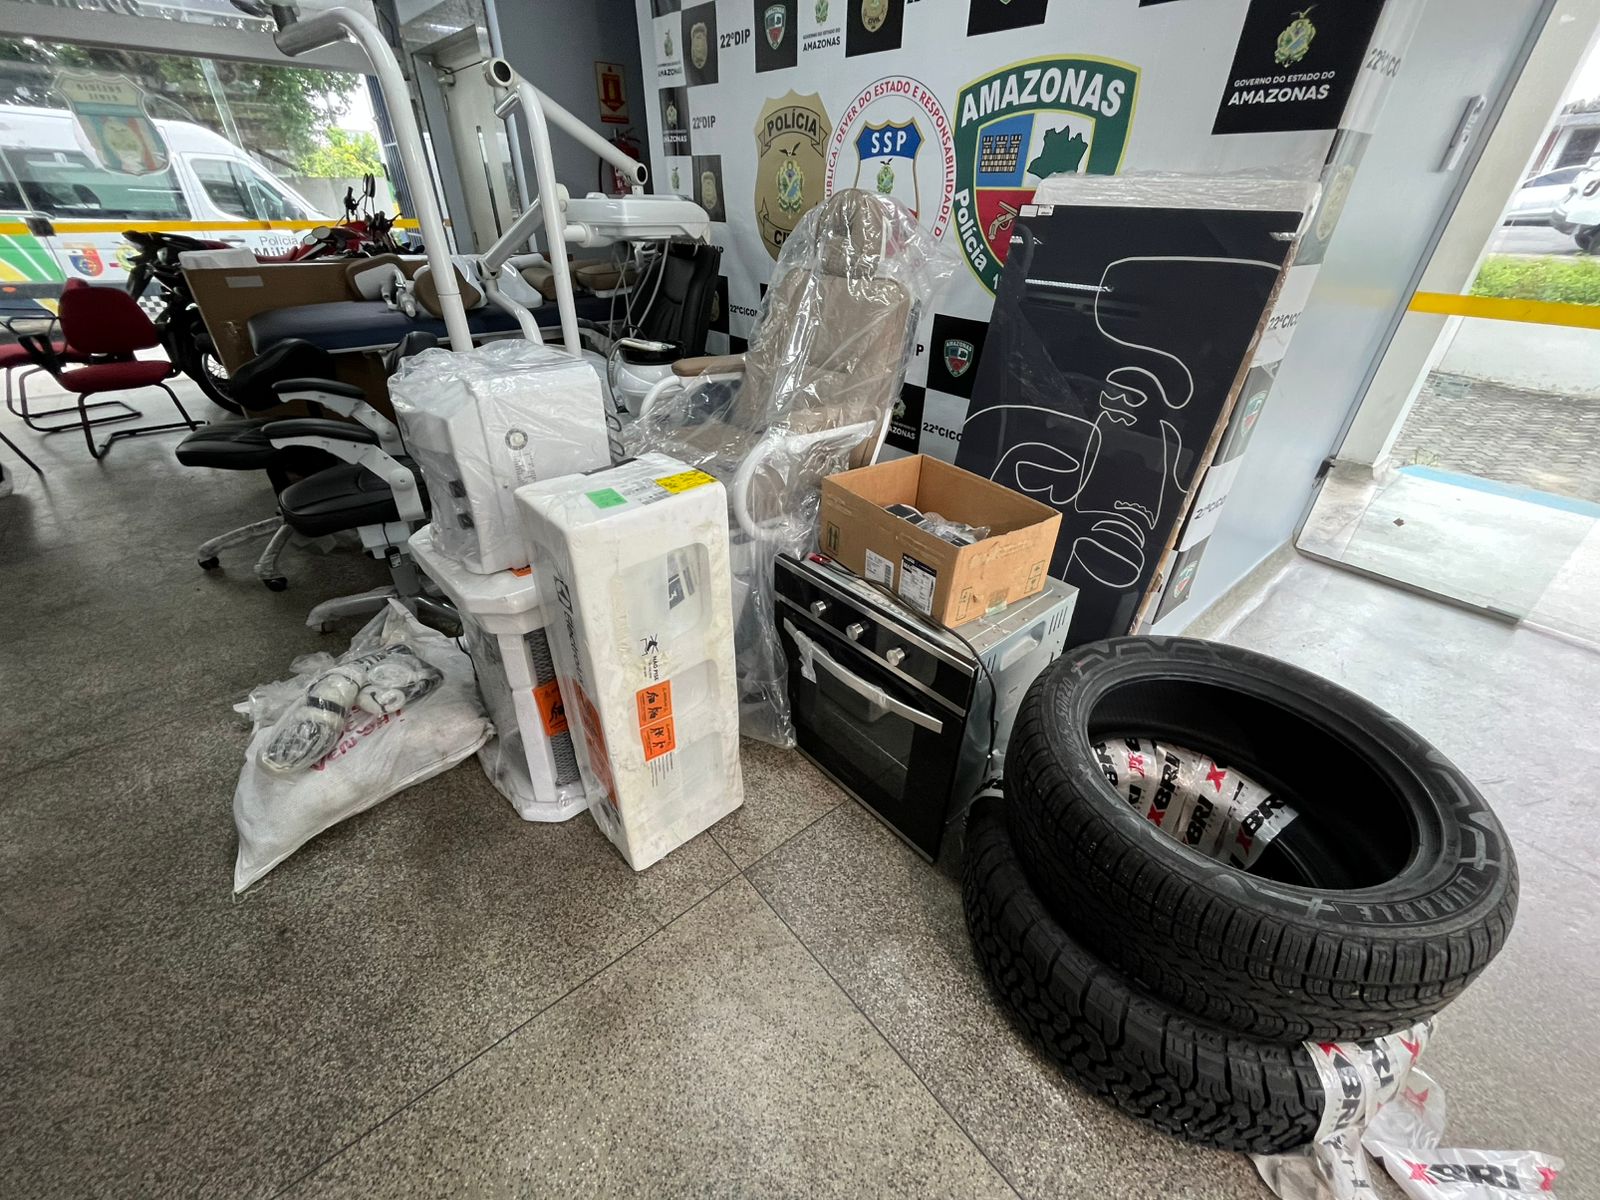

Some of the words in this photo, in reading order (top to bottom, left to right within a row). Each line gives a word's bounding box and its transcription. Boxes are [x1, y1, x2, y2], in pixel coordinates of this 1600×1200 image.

[802, 35, 841, 52] AMAZONAS
[960, 67, 1126, 128] AMAZONAS
[1228, 84, 1330, 106] AMAZONAS
[1234, 76, 1272, 88] GOVERNO
[1272, 75, 1286, 84] DO
[1287, 72, 1321, 83] ESTADO
[1321, 70, 1336, 79] DO
[766, 108, 818, 137] POLÍCIA
[836, 105, 859, 144] DEVER
[858, 90, 872, 109] DO
[874, 80, 911, 97] ESTADO
[912, 85, 920, 98] E
[919, 90, 954, 224] RESPONSABILIDADE
[871, 130, 907, 154] SSP
[954, 187, 988, 273] Polícia
[1147, 751, 1180, 827] XBRI
[1355, 875, 1483, 923] DURABLE
